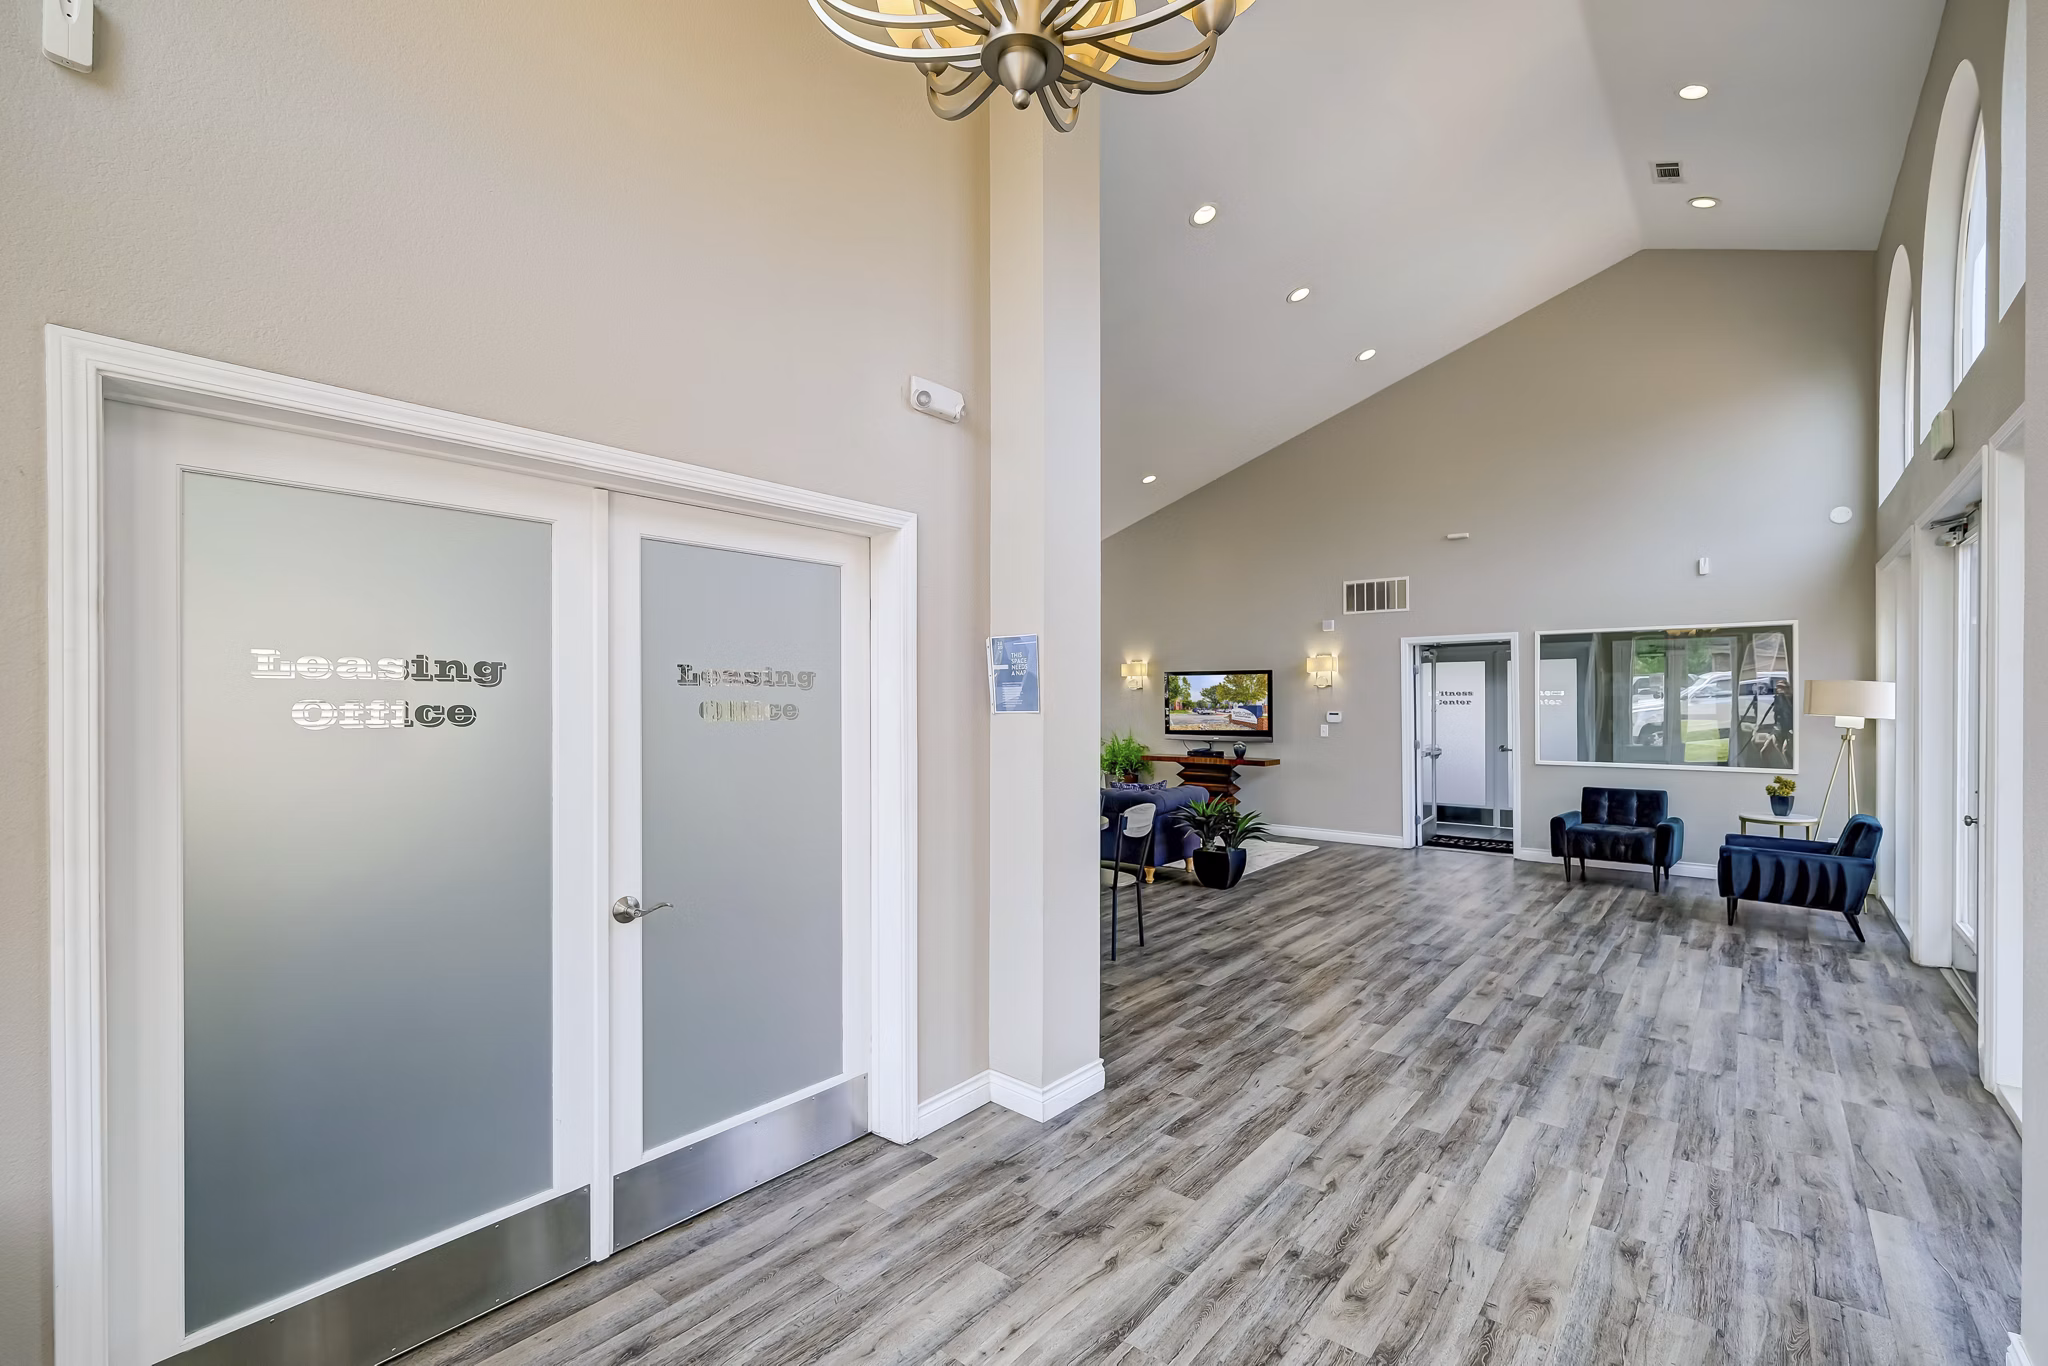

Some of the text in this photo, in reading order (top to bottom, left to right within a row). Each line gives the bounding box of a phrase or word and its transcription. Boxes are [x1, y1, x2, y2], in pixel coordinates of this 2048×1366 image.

[250, 647, 507, 688] Leasing
[676, 663, 817, 691] Leasing
[291, 698, 477, 731] Office
